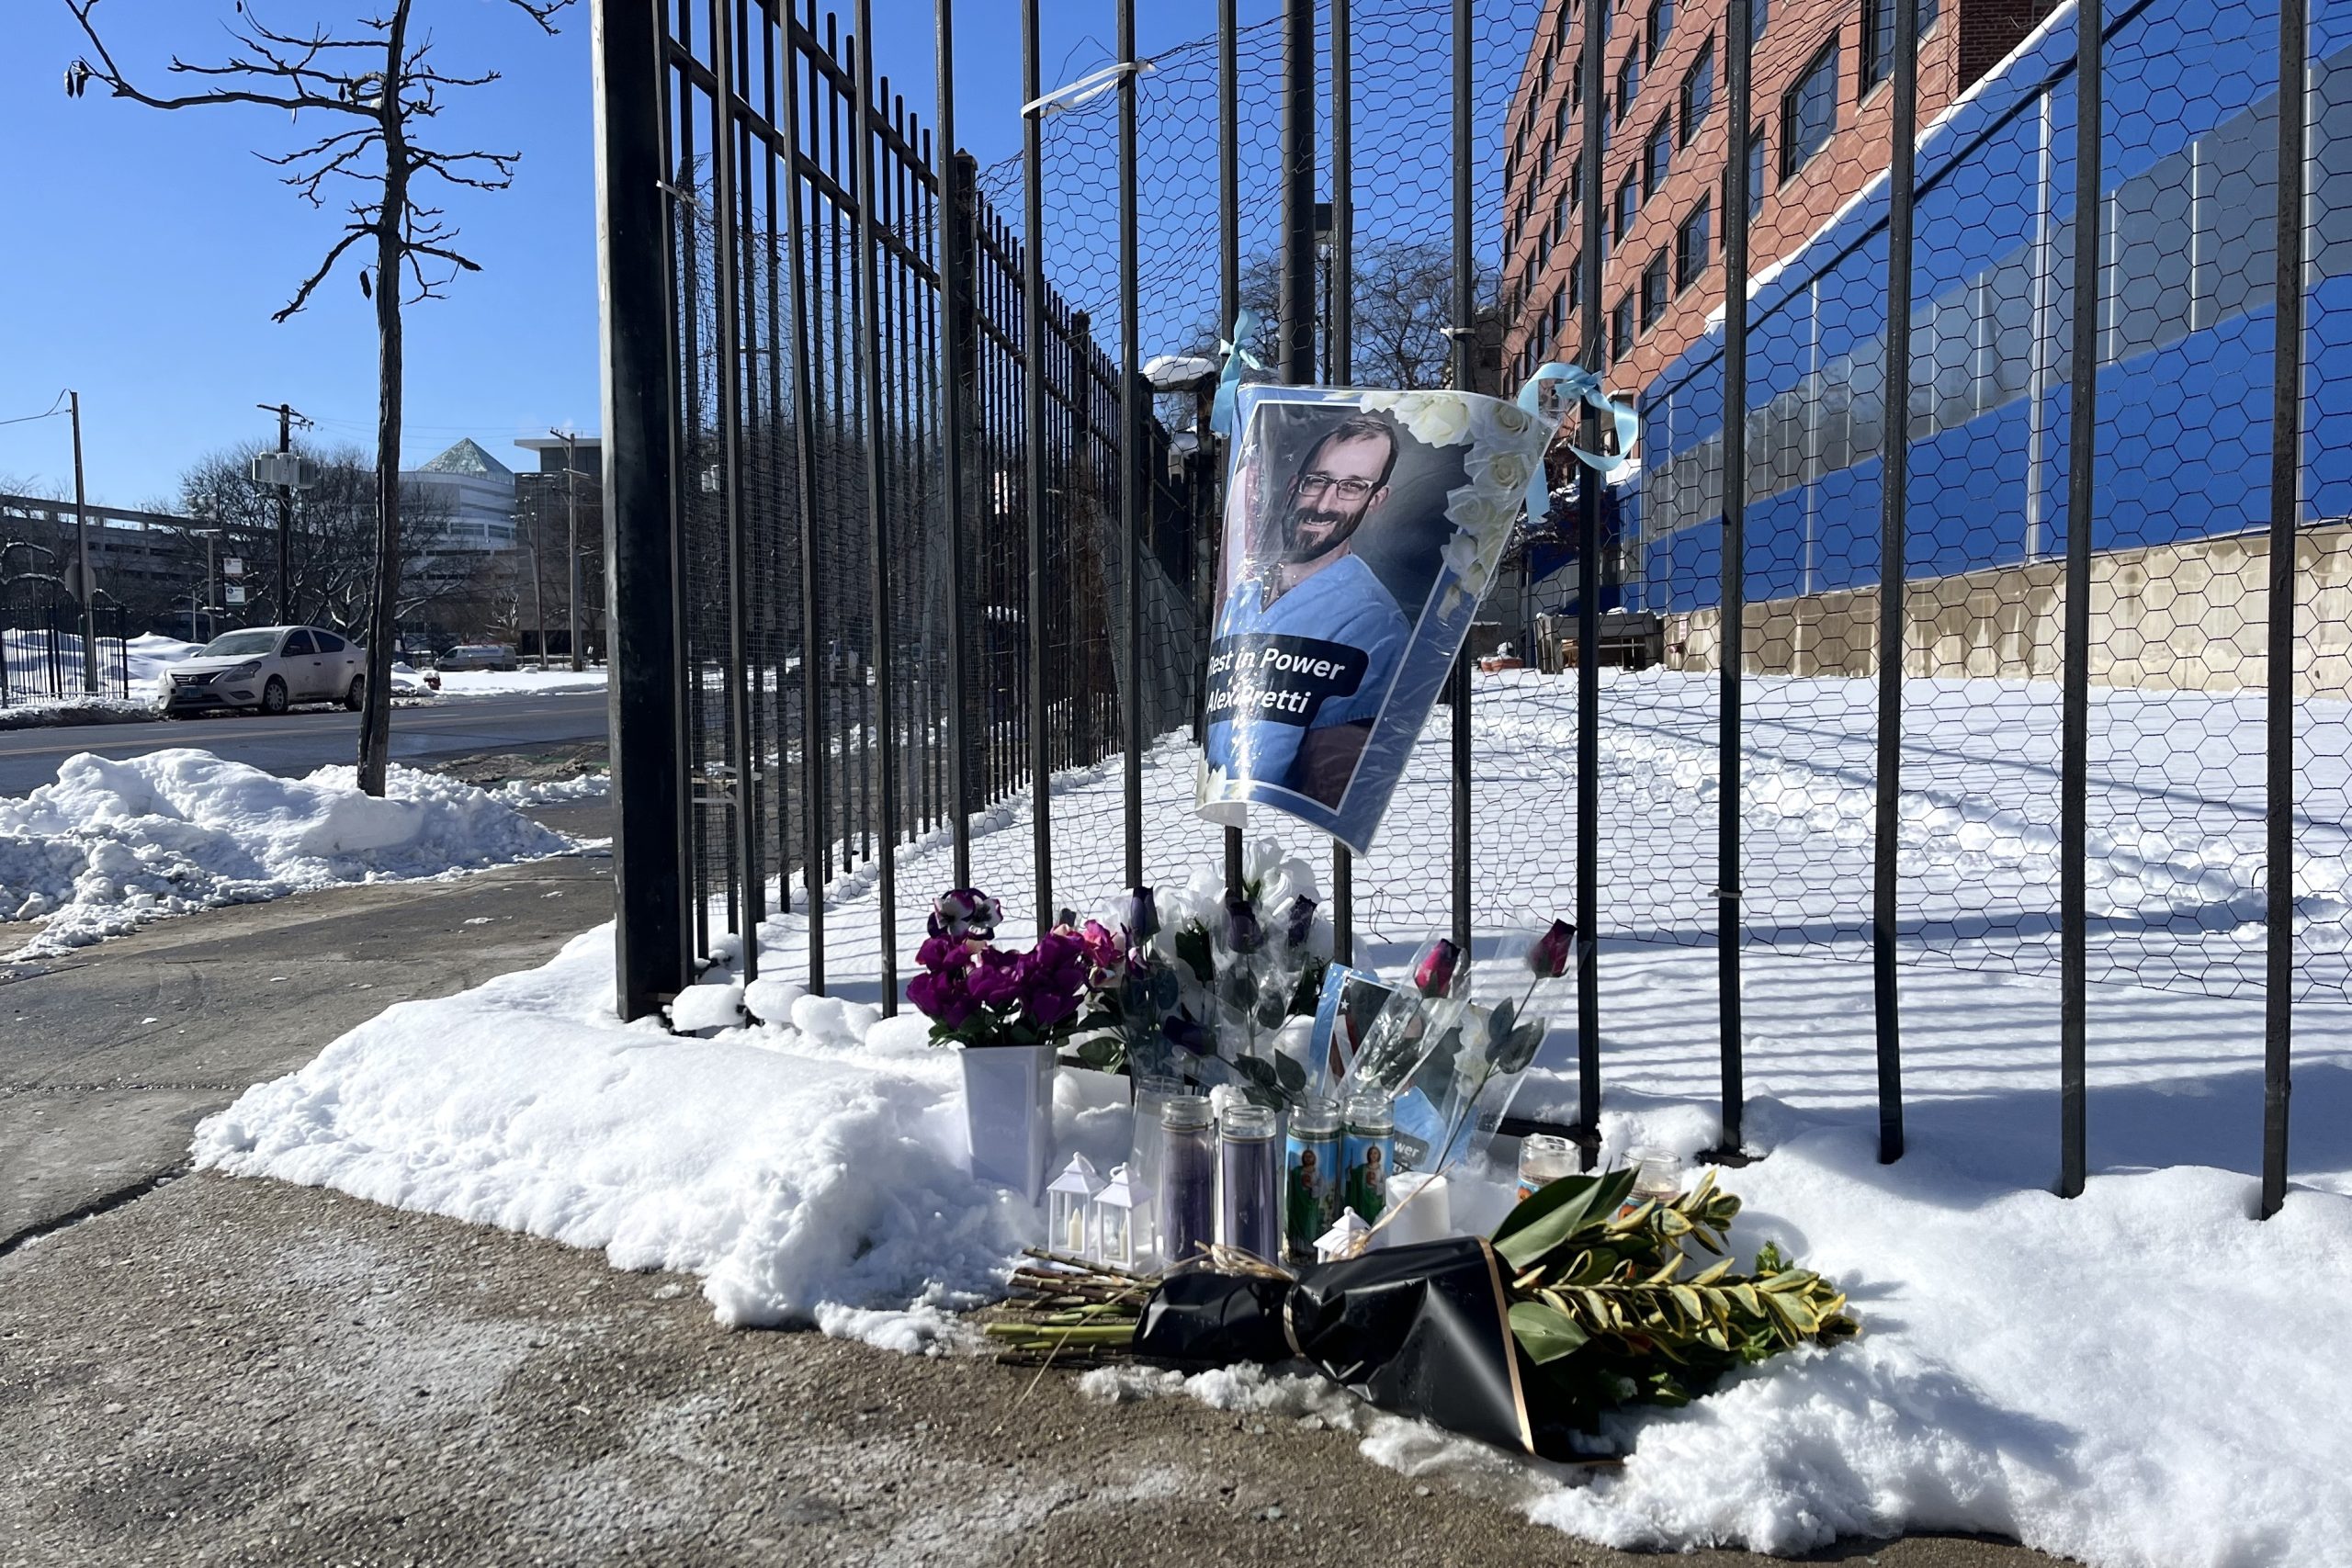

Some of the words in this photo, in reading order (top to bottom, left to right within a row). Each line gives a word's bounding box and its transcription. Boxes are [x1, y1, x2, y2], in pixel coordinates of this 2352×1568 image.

[1235, 647, 1256, 671] in
[1260, 648, 1345, 680] Power
[1206, 688, 1234, 714] Alex
[1238, 685, 1311, 714] Pretti
[1394, 1141, 1419, 1157] wer
